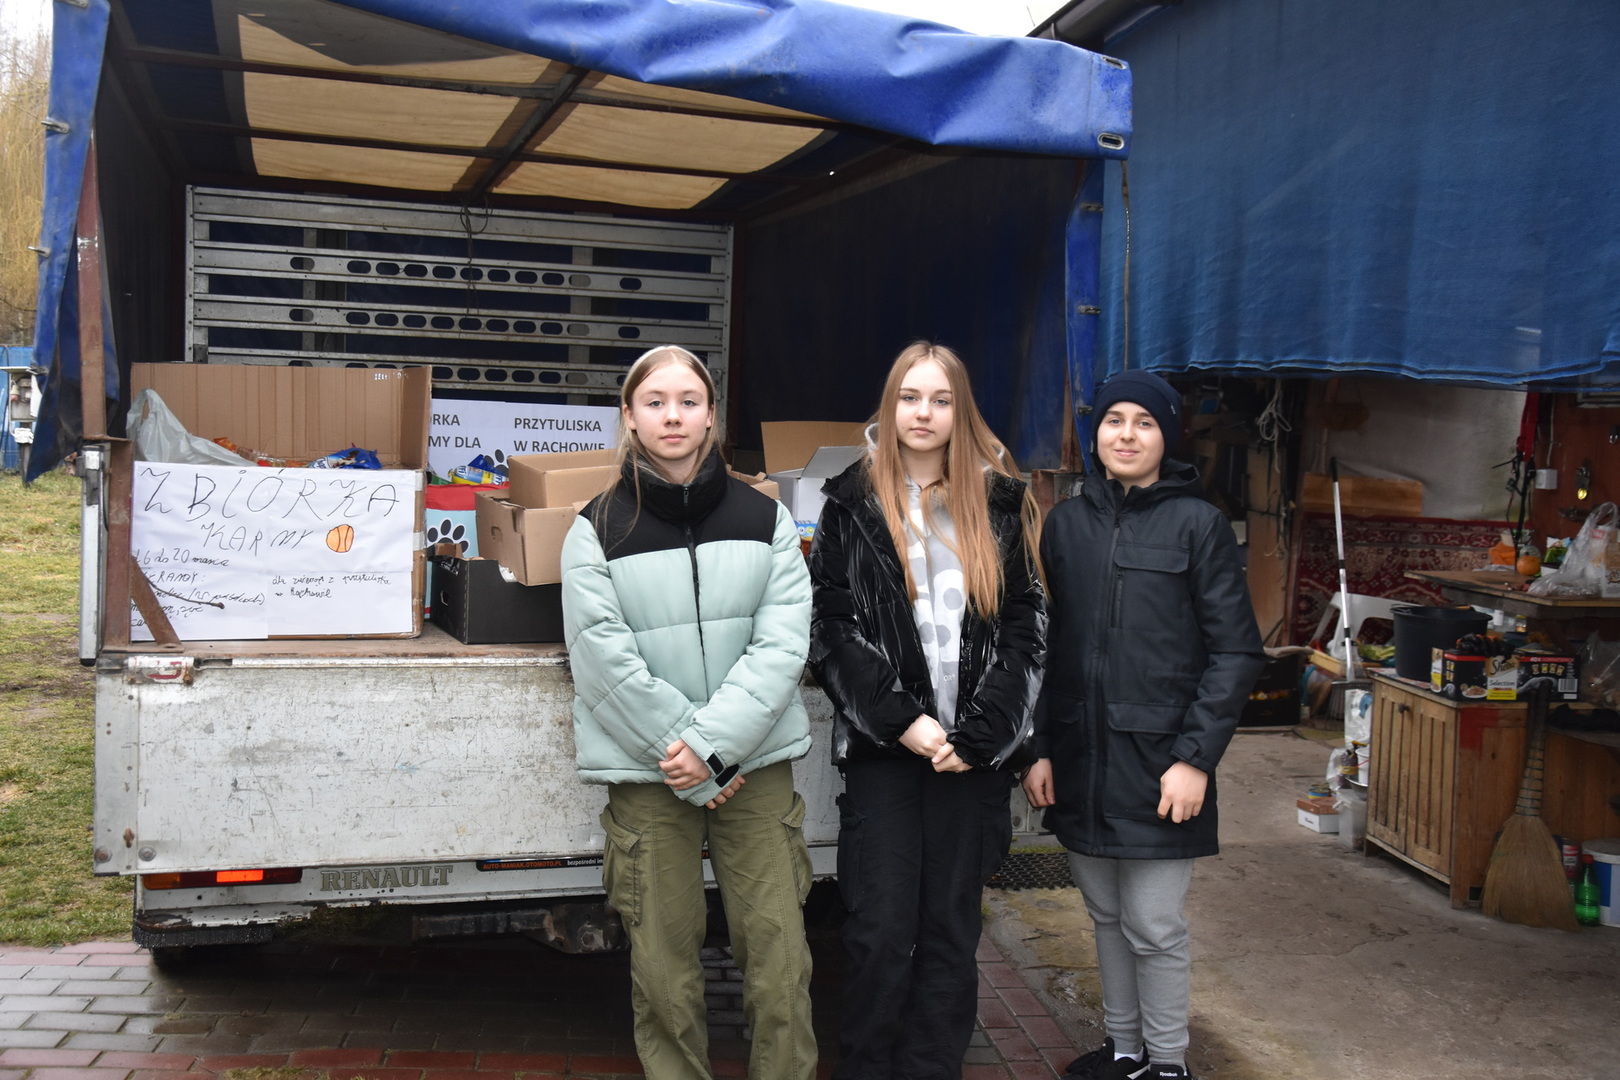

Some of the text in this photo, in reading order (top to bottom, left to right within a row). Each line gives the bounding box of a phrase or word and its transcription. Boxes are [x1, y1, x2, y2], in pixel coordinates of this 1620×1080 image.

[431, 413, 461, 426] RKA
[514, 417, 602, 432] PRZYTULISKA
[427, 435, 482, 449] MY DLA
[513, 440, 605, 453] W RACHOWIE
[200, 522, 315, 556] KARMY
[153, 547, 170, 563] do
[172, 547, 190, 564] 20
[272, 574, 287, 586] dla
[320, 864, 454, 892] RENAULT
